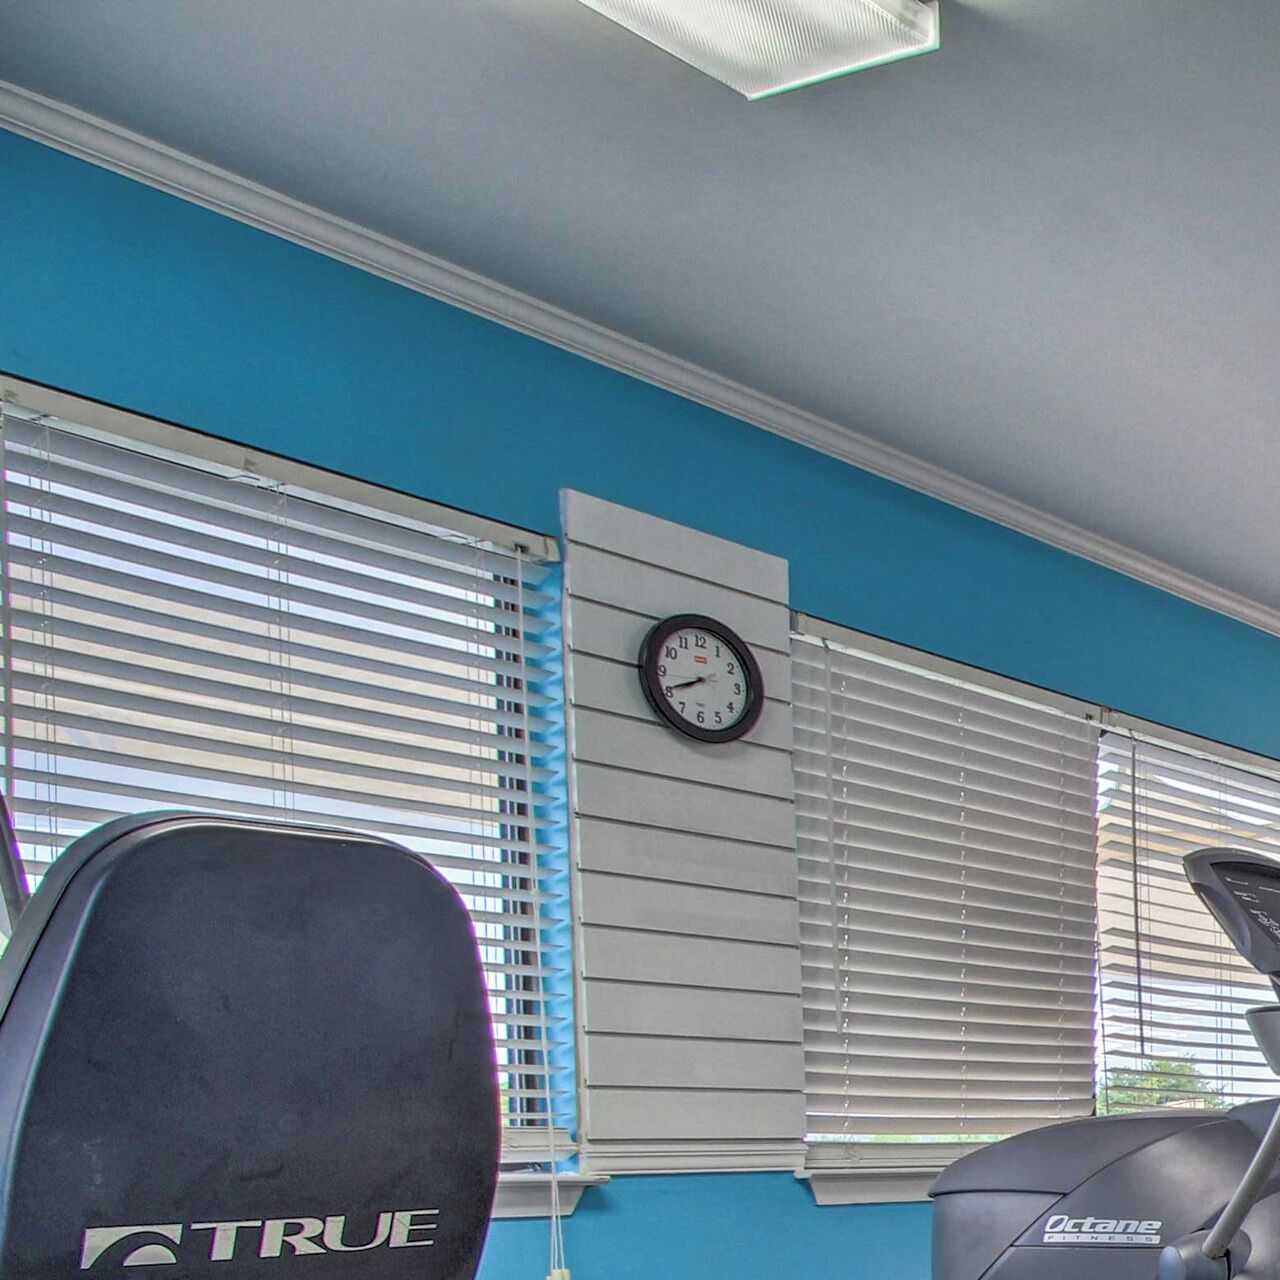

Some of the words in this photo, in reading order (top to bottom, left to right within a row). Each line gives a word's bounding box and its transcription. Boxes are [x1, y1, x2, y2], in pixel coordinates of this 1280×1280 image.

[679, 636, 688, 650] 11
[694, 635, 707, 649] 12
[665, 646, 678, 660] 10
[715, 646, 721, 658] 1
[658, 664, 667, 677] 9
[727, 662, 735, 675] 2
[664, 686, 673, 698] 8
[733, 683, 741, 695] 3
[678, 702, 686, 714] 7
[727, 702, 735, 713] 4
[696, 711, 705, 723] 6
[715, 711, 722, 724] 5
[1045, 1214, 1163, 1233] Octane
[190, 1208, 440, 1262] TRUE
[1047, 1235, 1154, 1243] FITNESS
